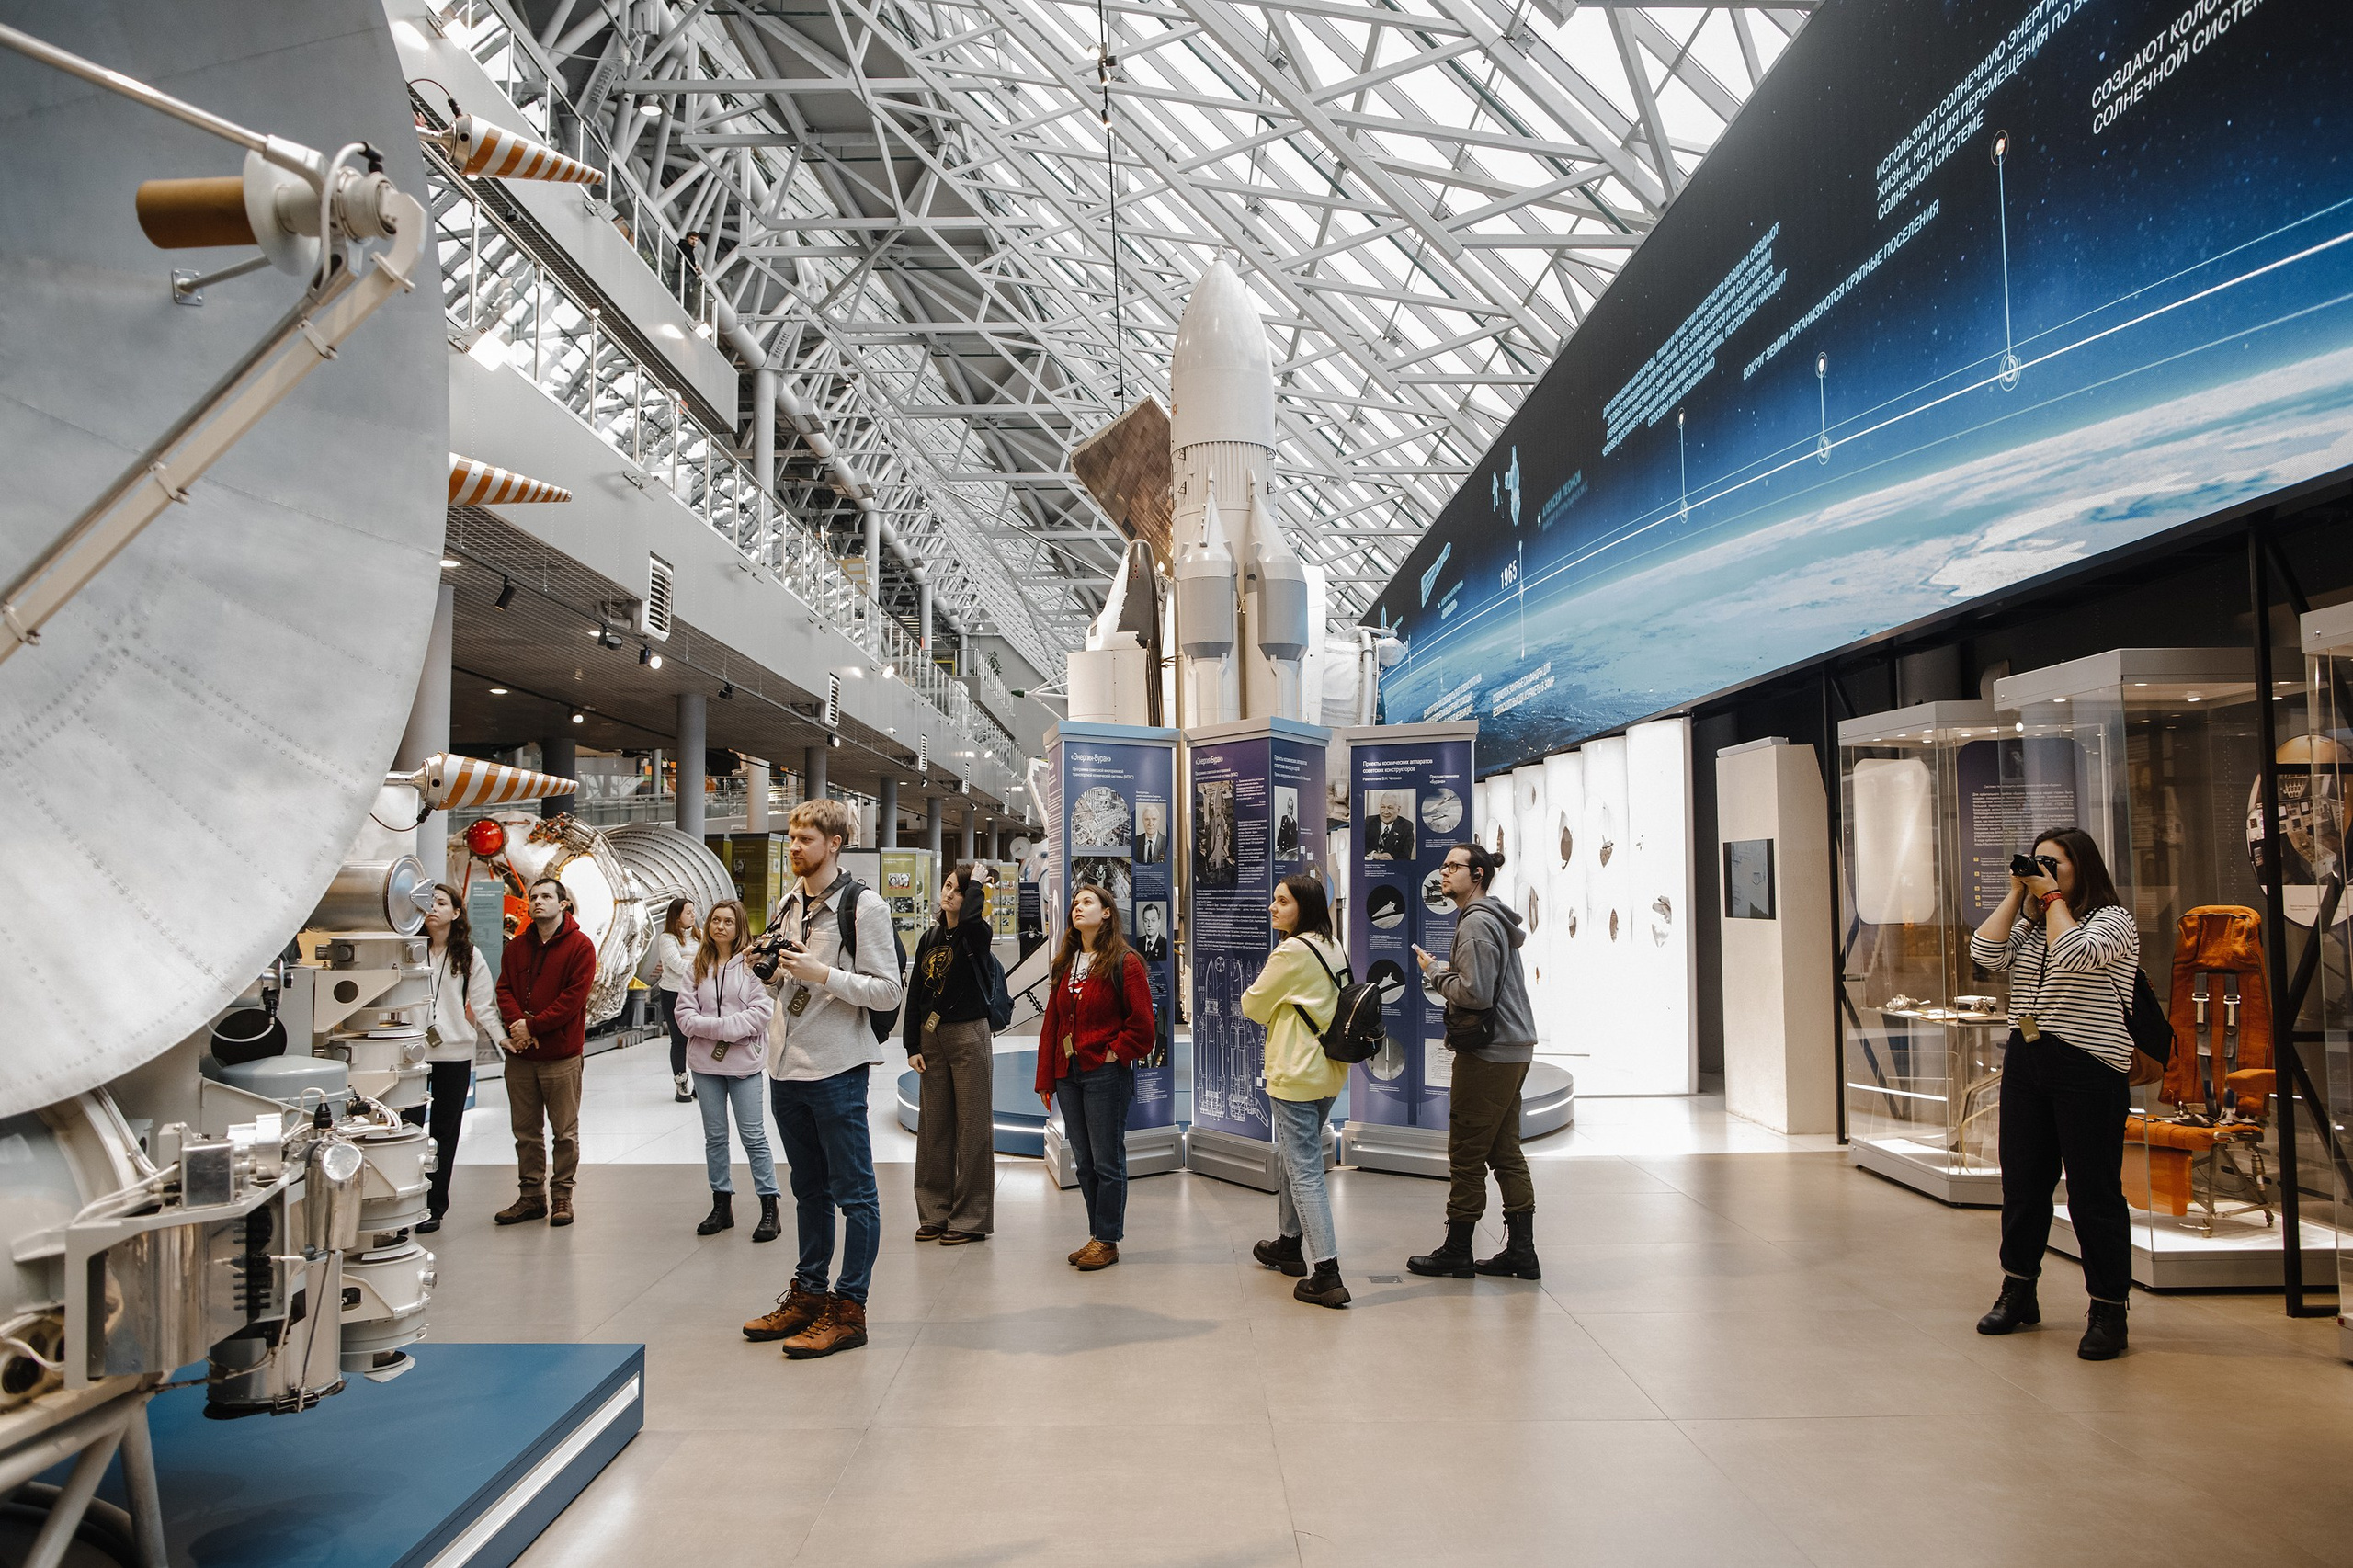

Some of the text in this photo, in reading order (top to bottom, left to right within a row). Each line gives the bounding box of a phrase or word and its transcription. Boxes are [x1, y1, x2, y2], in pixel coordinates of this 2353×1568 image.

[1876, 0, 2059, 180] ИСПОЛЬЗУЮТ СОЛНЕЧНУЮ ЭНЕРГИ
[1877, 159, 1912, 201] ЖИЗНИ,
[1914, 142, 1927, 165] НО
[1928, 131, 1937, 153] И
[1937, 111, 1960, 143] ДЛЯ
[1961, 22, 2049, 119] ПЕРЕМЕЩЕНИЯ
[2052, 3, 2071, 33] ПО
[2092, 0, 2222, 108] СОЗДАЮТ КОЛО
[2093, 0, 2262, 135] СОЛНЕЧНОЙ СИСТЕ
[1878, 109, 1984, 221] СОЛНЕЧНОЙ СИСТЕМЕ
[1736, 247, 1772, 294] СОСТОЯНИИ
[1743, 199, 1939, 381] ВОКРУГ ЗЕМЛИ ОРГАНИЗУЮТСЯ КРУПНЫЕ ПОСЕЛЕНИЯ
[1750, 221, 1779, 262] СОЗДАЮТ
[1757, 267, 1788, 307] НАХОДИТ
[1500, 559, 1518, 590] 1965
